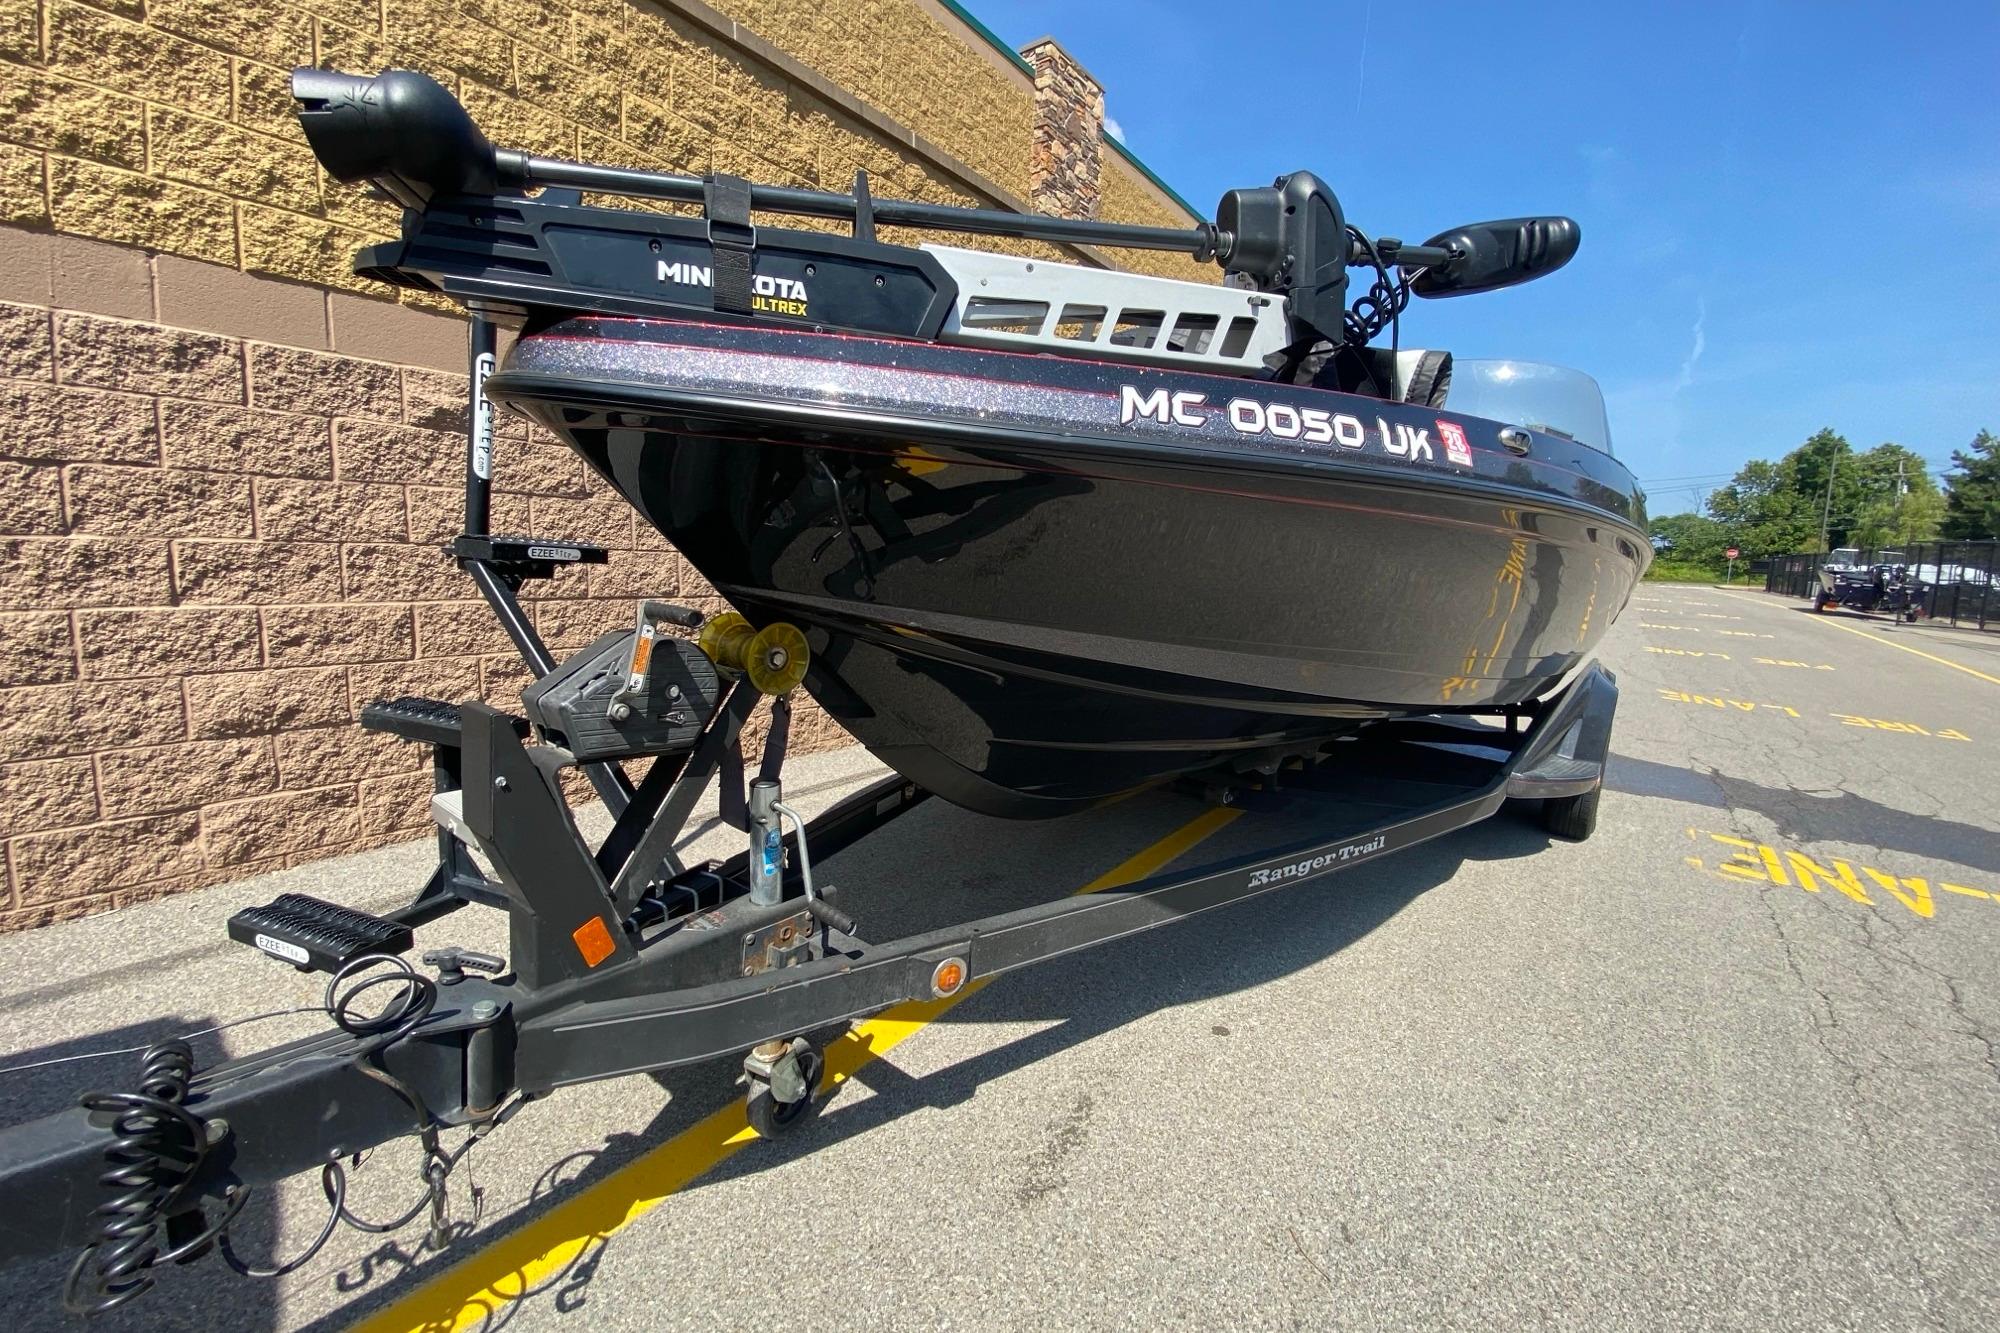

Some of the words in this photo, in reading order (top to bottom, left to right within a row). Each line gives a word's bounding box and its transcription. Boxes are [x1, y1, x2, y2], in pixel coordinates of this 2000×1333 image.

[657, 260, 714, 288] MIN
[752, 275, 808, 301] OTA
[752, 297, 807, 317] ULTREX
[1121, 385, 1207, 426] MC
[1228, 398, 1365, 449] 0050
[1377, 416, 1434, 463] UK
[531, 548, 555, 558] EZEE
[1248, 853, 1335, 887] Ranger
[1338, 835, 1386, 861] Trail
[259, 937, 280, 952] EZEE
